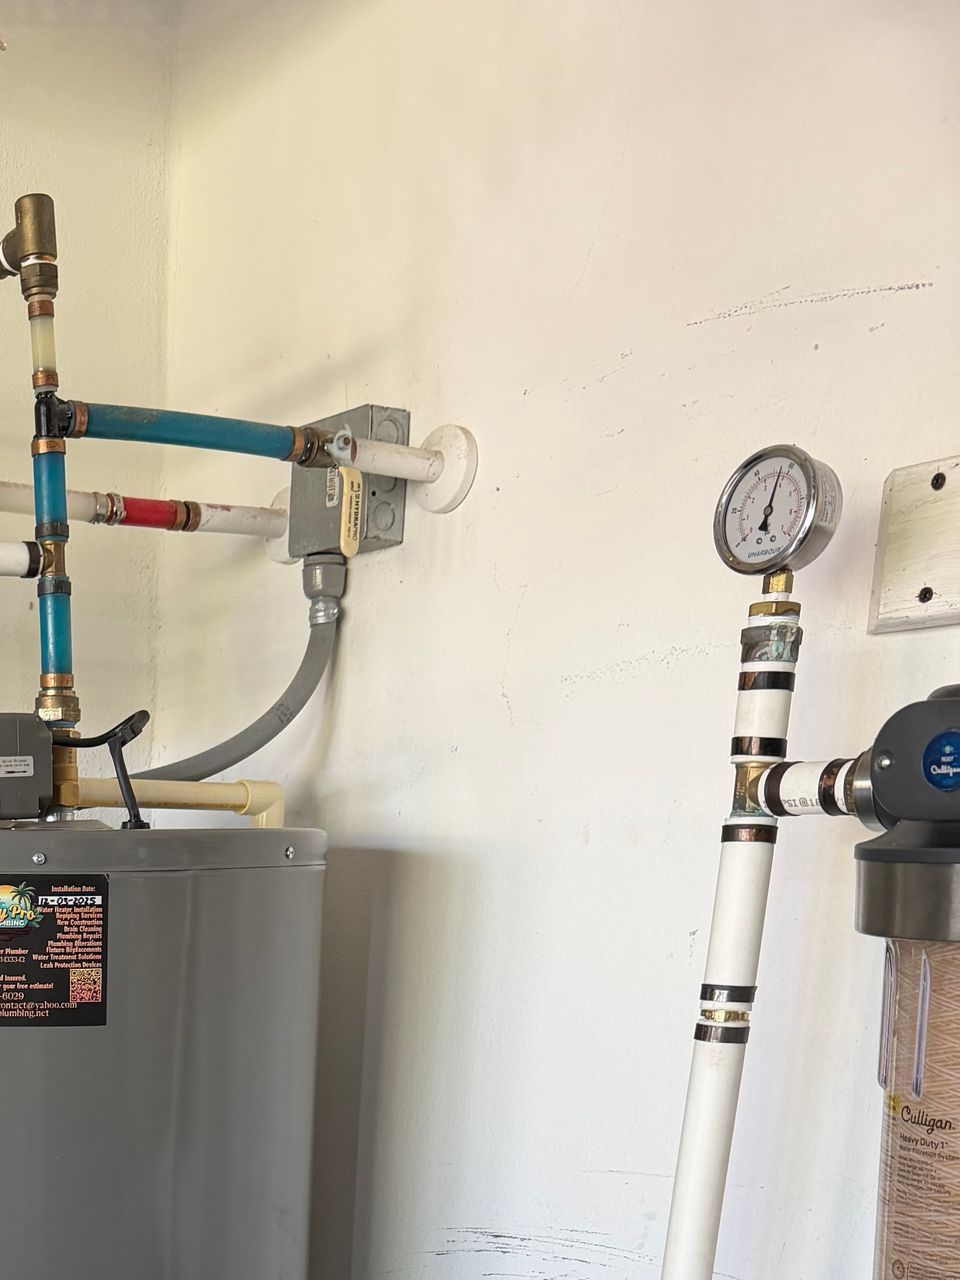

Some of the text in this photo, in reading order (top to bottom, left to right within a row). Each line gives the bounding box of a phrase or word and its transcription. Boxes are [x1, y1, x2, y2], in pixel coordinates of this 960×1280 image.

[10, 904, 34, 921] Pro
[55, 912, 80, 920] Repiping
[47, 940, 73, 948] Plumbing
[65, 946, 102, 954] Replacements
[900, 1105, 952, 1134] Culligan
[900, 1132, 939, 1150] Heavy Duty
